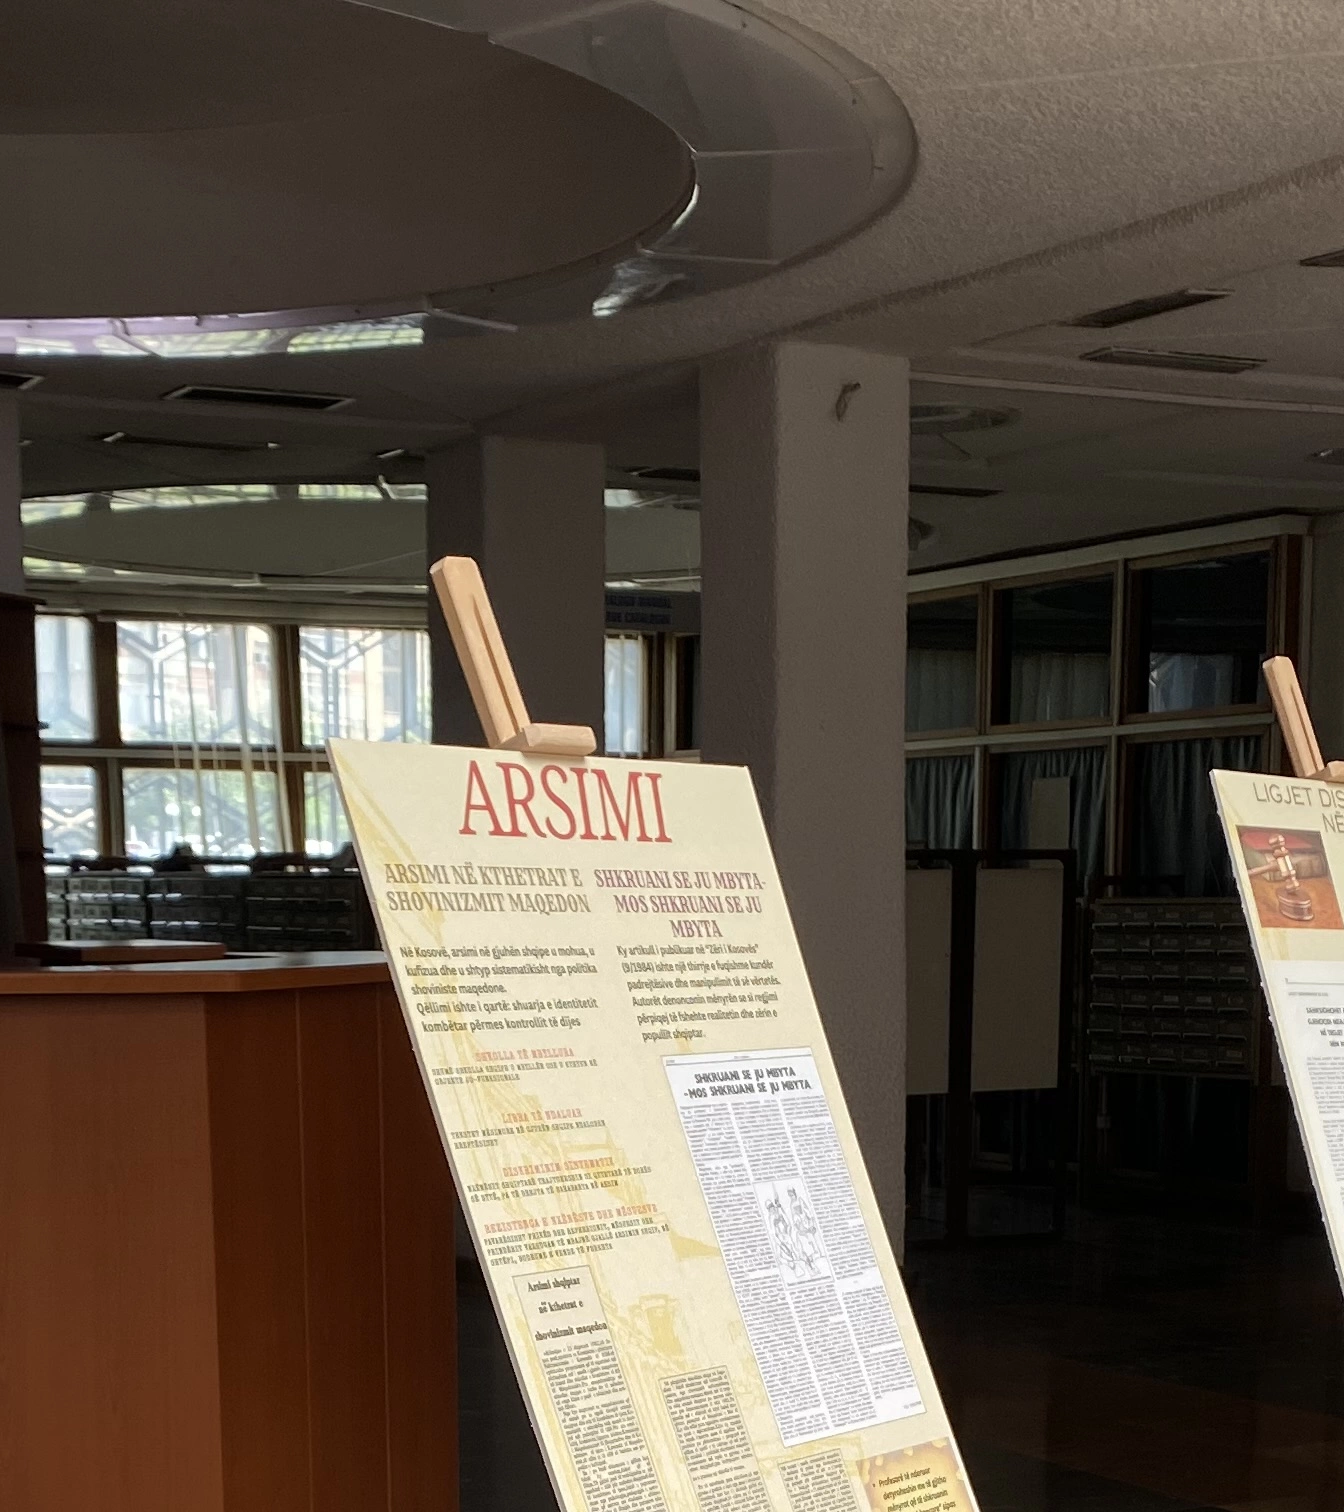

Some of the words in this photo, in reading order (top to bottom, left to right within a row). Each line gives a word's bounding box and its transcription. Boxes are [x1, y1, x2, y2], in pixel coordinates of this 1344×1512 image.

[459, 760, 672, 843] ARSIMI
[1253, 782, 1312, 806] LIGJET
[384, 863, 450, 886] ARSIMI
[450, 862, 478, 885] NË
[477, 865, 567, 886] KTHETRAT
[569, 868, 583, 887] E
[593, 869, 671, 888] SHKRUANI
[672, 870, 692, 888] SE
[693, 871, 711, 889] JU
[712, 871, 765, 889] MBYTA-
[386, 890, 504, 913] SHOVINIZMIT
[507, 892, 590, 914] MAQEDON
[613, 894, 648, 913] MOS
[649, 895, 724, 913] SHKRUANI
[724, 895, 744, 913] SE
[744, 895, 762, 913] JU
[669, 919, 722, 937] MBYTA
[399, 945, 414, 957] Në
[413, 944, 451, 959] Kosovë,
[450, 945, 478, 957] arsimi
[478, 945, 490, 957] në
[491, 945, 521, 959] gjuhën
[521, 945, 550, 959] shqipe
[550, 947, 557, 956] u
[557, 945, 589, 958] mohua,
[588, 947, 595, 956] u
[410, 982, 457, 997] shoviniste
[457, 981, 506, 996] maqedone.
[694, 1070, 740, 1083] SHKRUANI
[741, 1069, 752, 1079] SE
[753, 1068, 764, 1081] JU
[765, 1066, 796, 1078] MBYTA
[683, 1087, 707, 1098] -MOS
[709, 1083, 755, 1096] SHKRUANI
[756, 1081, 767, 1092] SE
[768, 1081, 779, 1094] JU
[780, 1079, 811, 1090] MBYTA
